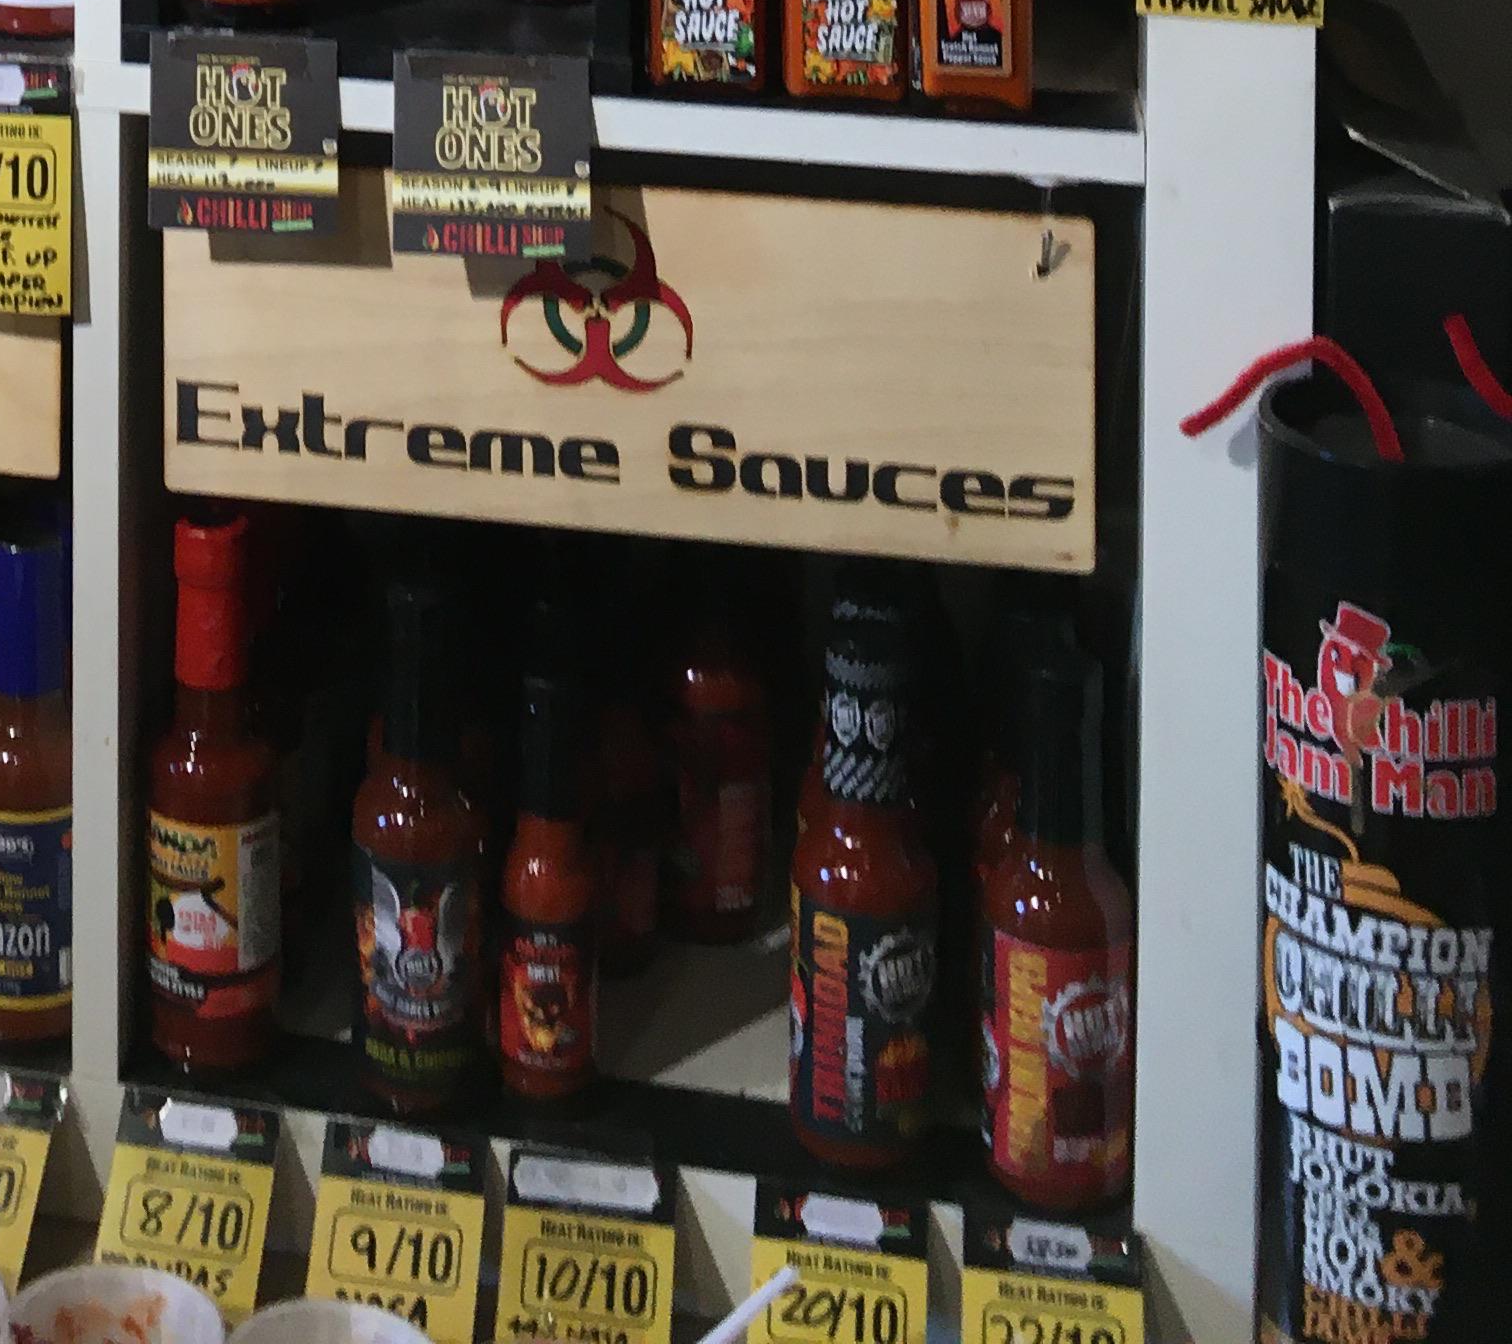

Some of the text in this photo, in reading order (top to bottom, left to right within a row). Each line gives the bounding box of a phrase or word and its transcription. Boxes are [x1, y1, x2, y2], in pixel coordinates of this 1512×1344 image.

[674, 12, 740, 43] SAUCE
[824, 0, 869, 22] HOT
[817, 24, 878, 54] SAUCE
[195, 65, 287, 109] HOT
[189, 106, 291, 150] ONES
[443, 89, 536, 131] HOT
[435, 128, 540, 173] ONES
[197, 198, 269, 228] CHILLI
[444, 224, 517, 254] CHILLI
[175, 379, 1075, 521] Extreme Sauces
[1375, 758, 1496, 818] Man
[1290, 842, 1340, 897] THE
[1264, 863, 1492, 975] CHAMPION
[534, 1255, 648, 1313] 10/10
